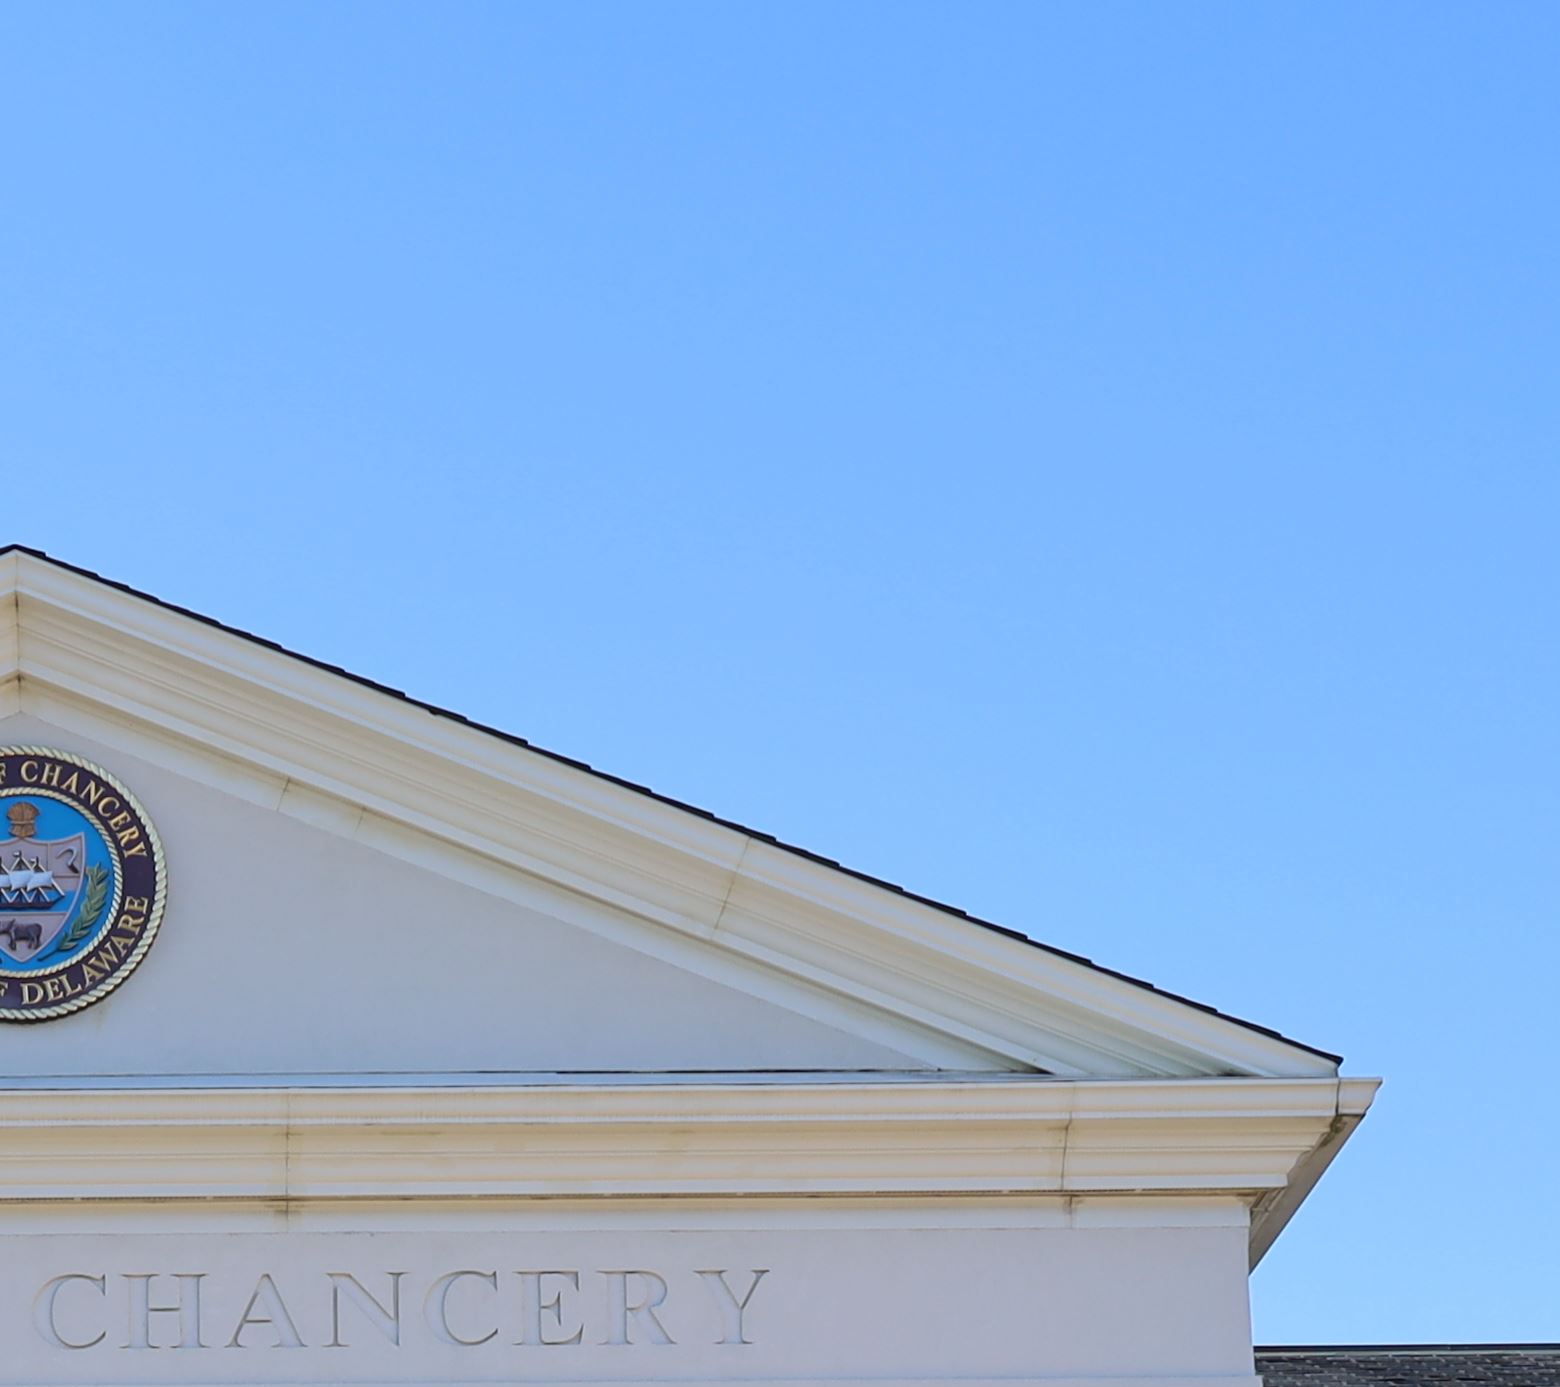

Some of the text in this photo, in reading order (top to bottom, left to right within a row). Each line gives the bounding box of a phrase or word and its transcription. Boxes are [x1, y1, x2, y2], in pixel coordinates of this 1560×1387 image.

[20, 760, 147, 858] CHANCERY
[20, 895, 148, 1005] DELAWARE
[32, 1269, 771, 1349] CHANCERY
